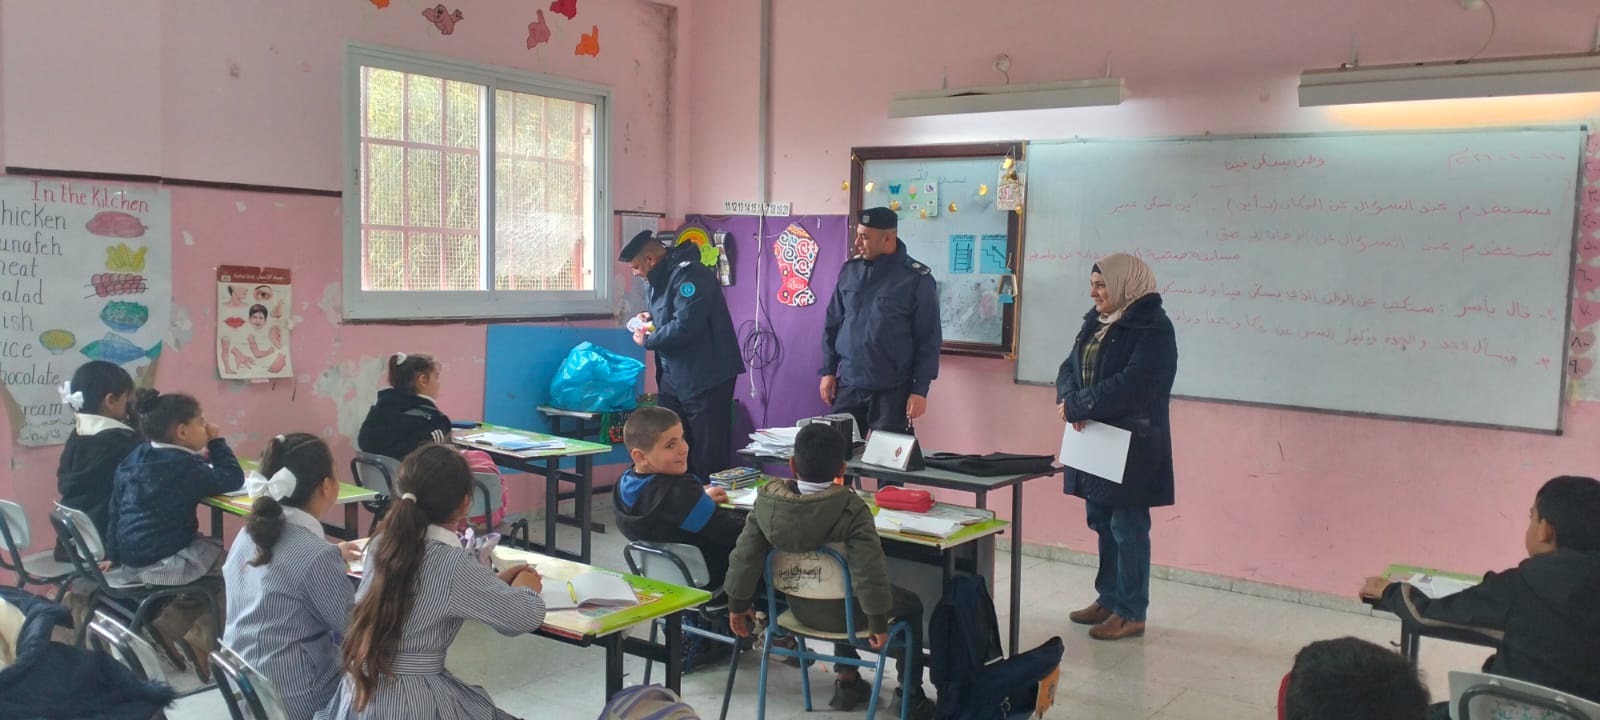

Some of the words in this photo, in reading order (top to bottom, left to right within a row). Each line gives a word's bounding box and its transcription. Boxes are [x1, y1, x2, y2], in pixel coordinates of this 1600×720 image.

[32, 180, 56, 203] In
[0, 201, 67, 231] hicken
[1, 279, 44, 305] alad
[3, 306, 34, 332] ish
[0, 339, 33, 359] ice
